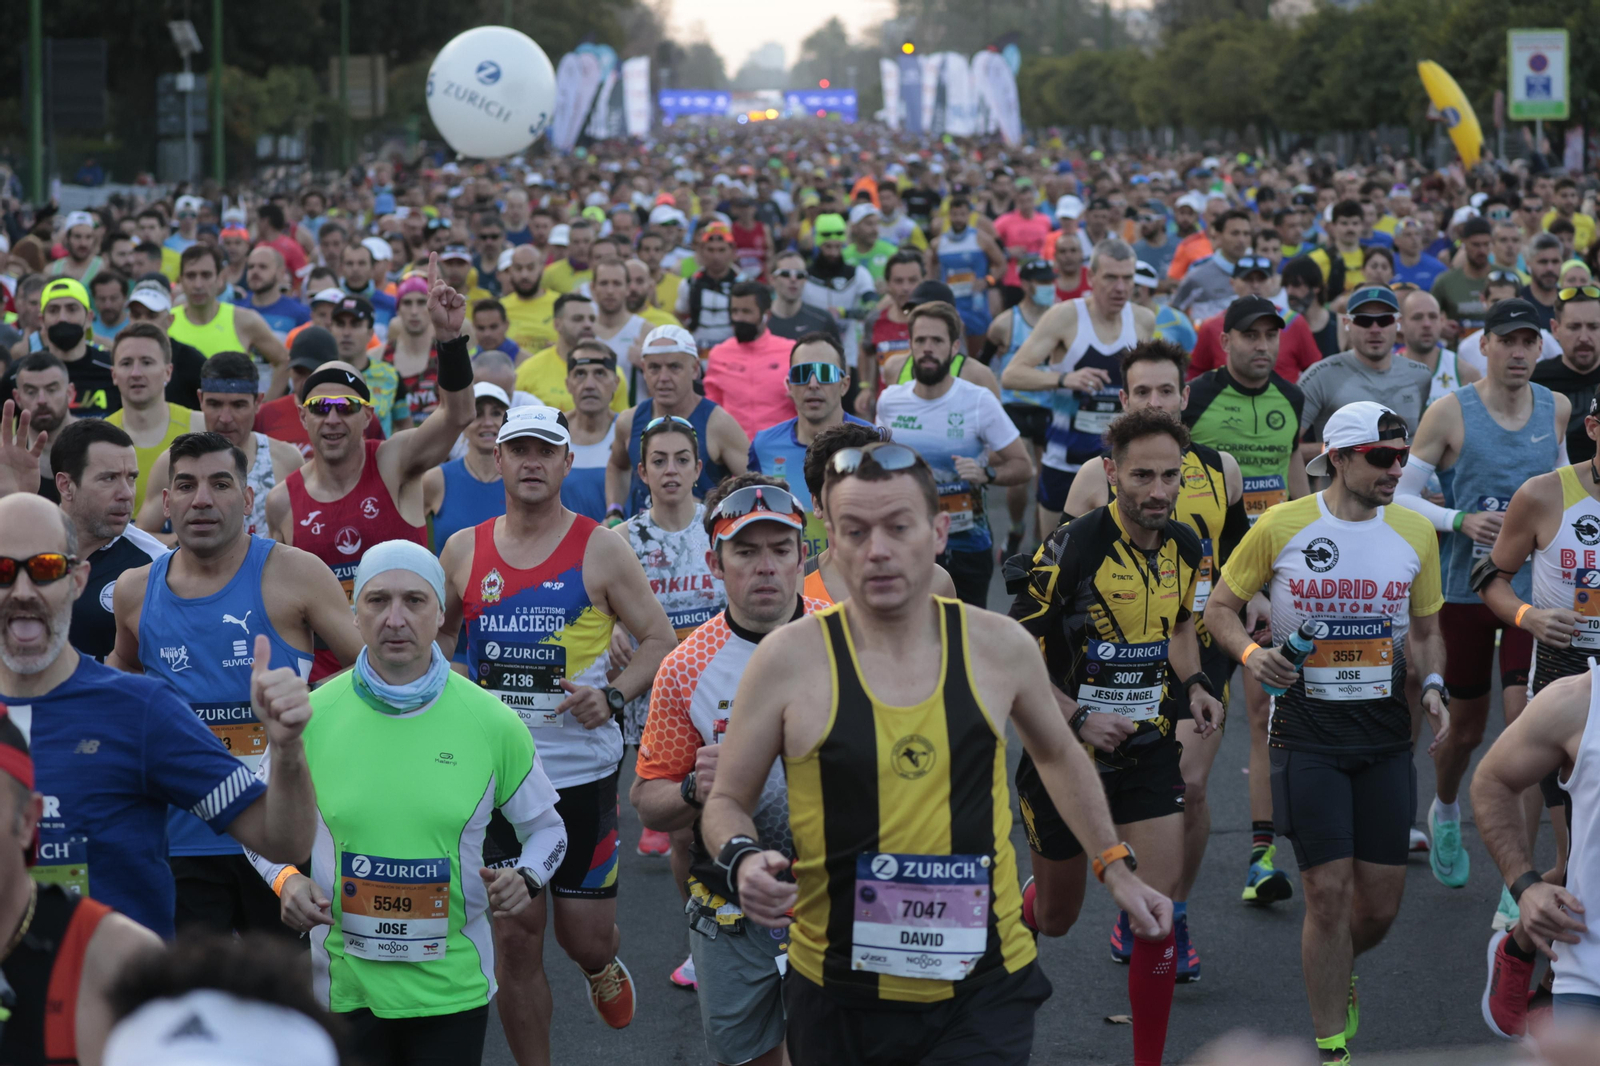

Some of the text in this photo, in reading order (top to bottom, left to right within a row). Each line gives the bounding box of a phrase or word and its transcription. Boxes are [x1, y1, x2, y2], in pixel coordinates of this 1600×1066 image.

[443, 80, 512, 123] ZURICH
[1244, 480, 1280, 490] ZURICH
[1289, 578, 1378, 600] MADRID
[1293, 599, 1373, 614] MARATÓN
[479, 614, 566, 632] PALACIEGO
[669, 612, 711, 626] ZURICH
[1332, 624, 1382, 636] ZURICH
[503, 646, 556, 660] ZURICH
[1118, 645, 1162, 658] ZURICH
[1332, 650, 1363, 662] 3557
[502, 672, 534, 688] 2136
[1114, 672, 1144, 684] 3007
[1335, 670, 1361, 680] JOSE
[501, 694, 535, 706] FRANK
[1091, 690, 1154, 702] JESÚS ÁNGEL
[196, 706, 252, 721] ZURICH
[36, 842, 69, 859] ICH
[374, 862, 438, 878] ZURICH
[902, 862, 976, 879] ZURICH
[373, 895, 412, 912] 5549
[902, 900, 947, 919] 7047
[375, 922, 408, 936] JOSE
[900, 931, 944, 947] DAVID
